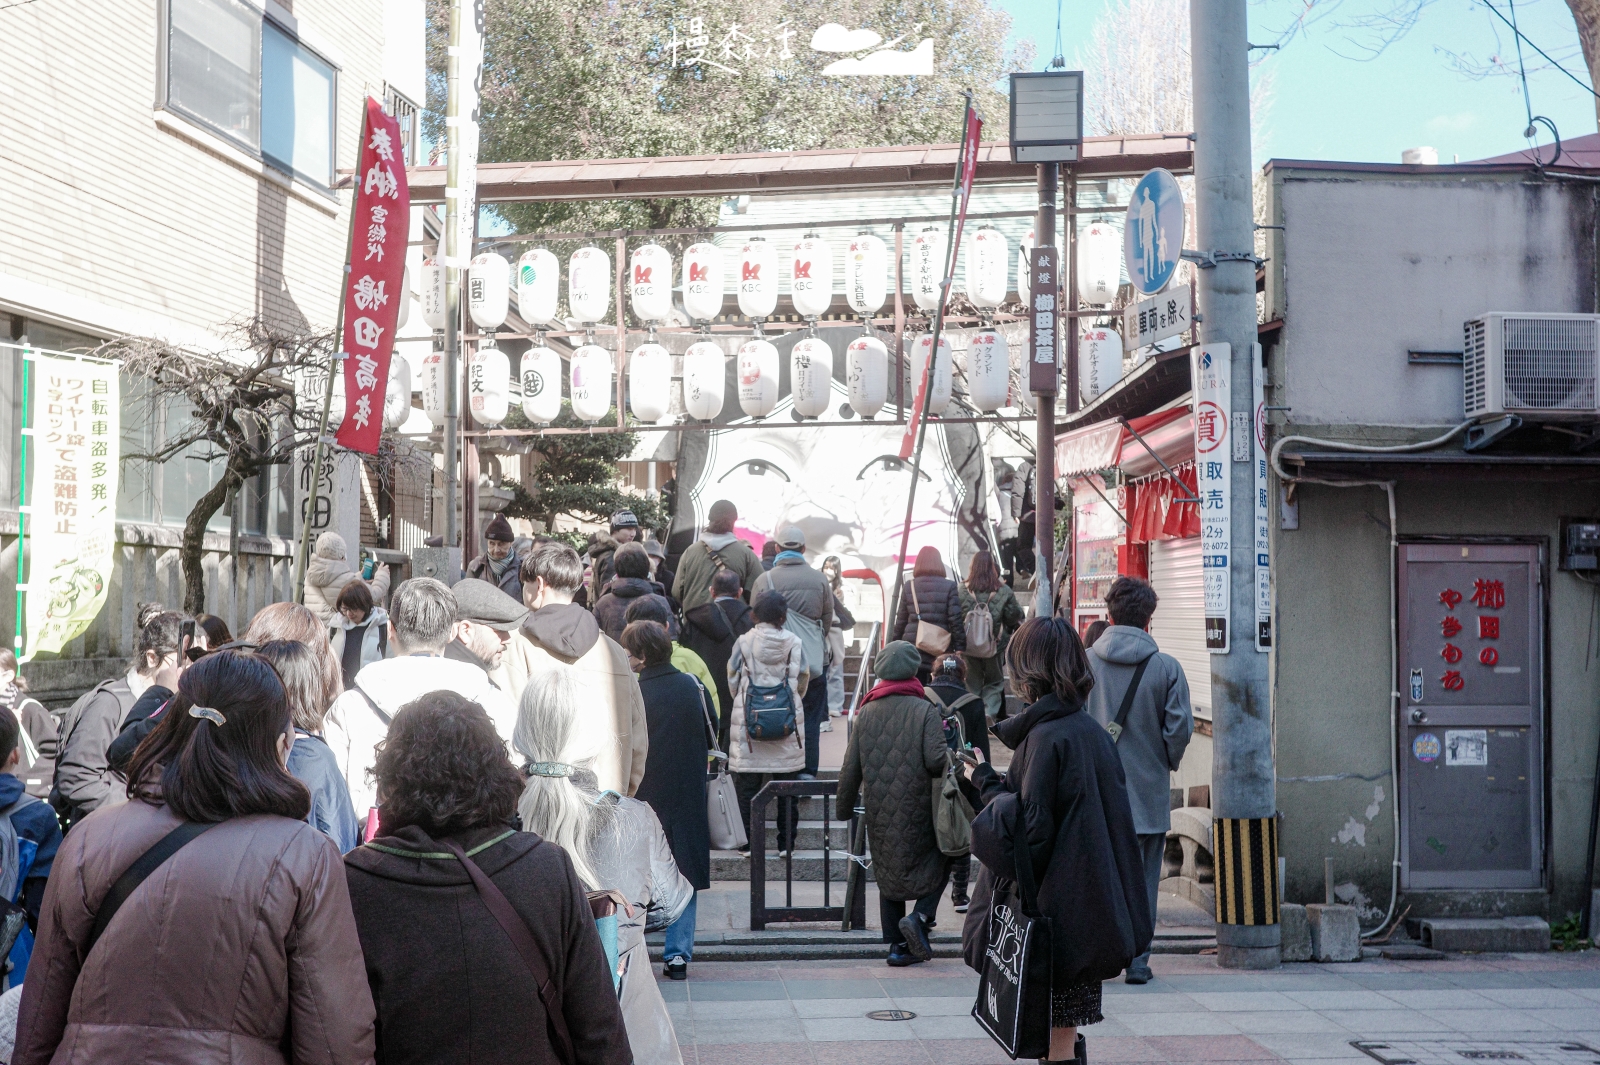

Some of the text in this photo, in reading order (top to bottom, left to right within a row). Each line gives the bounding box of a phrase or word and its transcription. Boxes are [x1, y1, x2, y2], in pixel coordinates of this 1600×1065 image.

[634, 284, 654, 297] KBC
[689, 283, 710, 295] KBC
[741, 282, 762, 294] KBC
[794, 280, 814, 291] KBC
[1035, 255, 1055, 364] 献燈 櫛田茶屋
[972, 334, 996, 345] 献燈
[1084, 330, 1108, 342] 献燈
[472, 364, 485, 393] 紀文
[1089, 341, 1101, 396] ホテルオークラ福岡
[1198, 410, 1218, 443] 質
[53, 448, 78, 535] で盗難防止
[1471, 578, 1506, 666] 櫛田の
